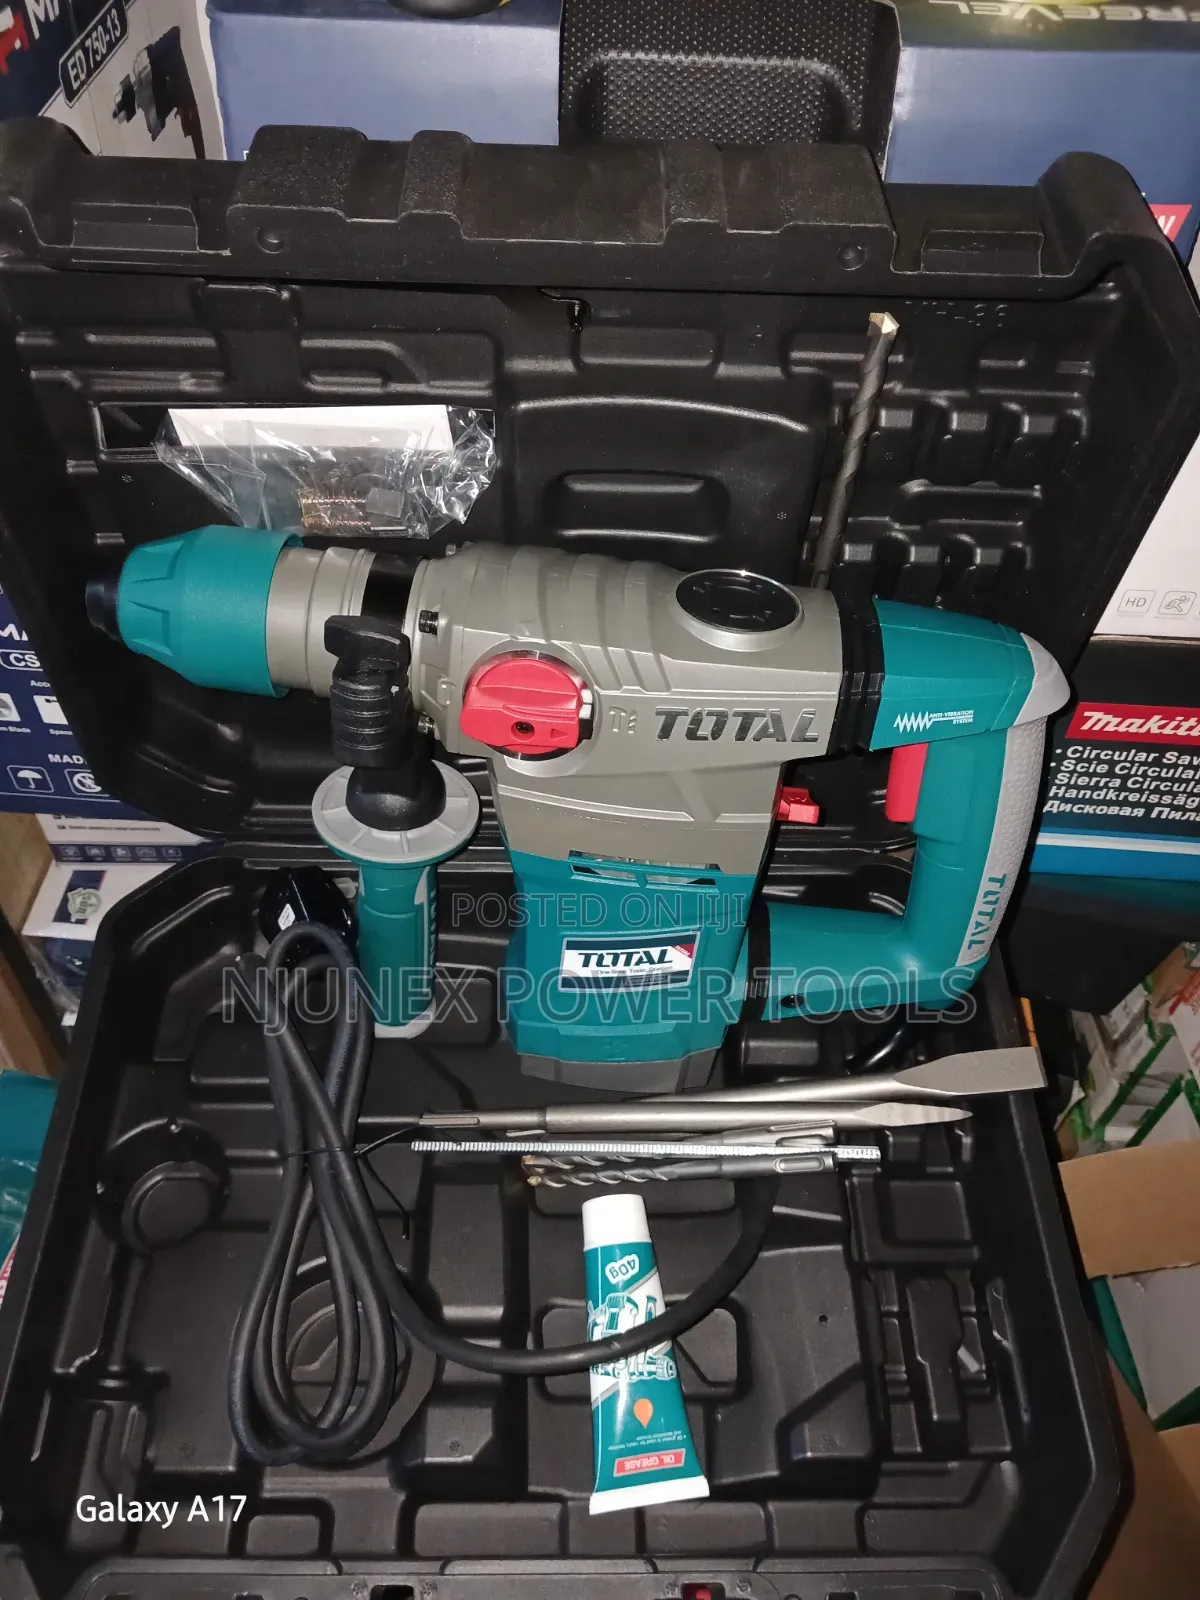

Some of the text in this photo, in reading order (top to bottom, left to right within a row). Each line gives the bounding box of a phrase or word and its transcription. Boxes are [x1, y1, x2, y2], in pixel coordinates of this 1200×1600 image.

[67, 8, 121, 91] ED 750-13
[1125, 597, 1147, 607] HD
[9, 653, 41, 668] CS
[928, 709, 975, 719] ANTI-VIBRATION
[655, 706, 820, 743] TOTAL
[47, 753, 88, 766] MAD
[1066, 745, 1159, 763] Circular
[1060, 759, 1109, 773] Scie
[1054, 772, 1122, 788] Sierra
[1043, 800, 1146, 818] Дисковая
[966, 873, 1008, 950] TOTAL
[578, 949, 673, 967] TOTAL
[608, 1258, 637, 1280] 40g
[623, 1453, 675, 1471] OIL GREASE
